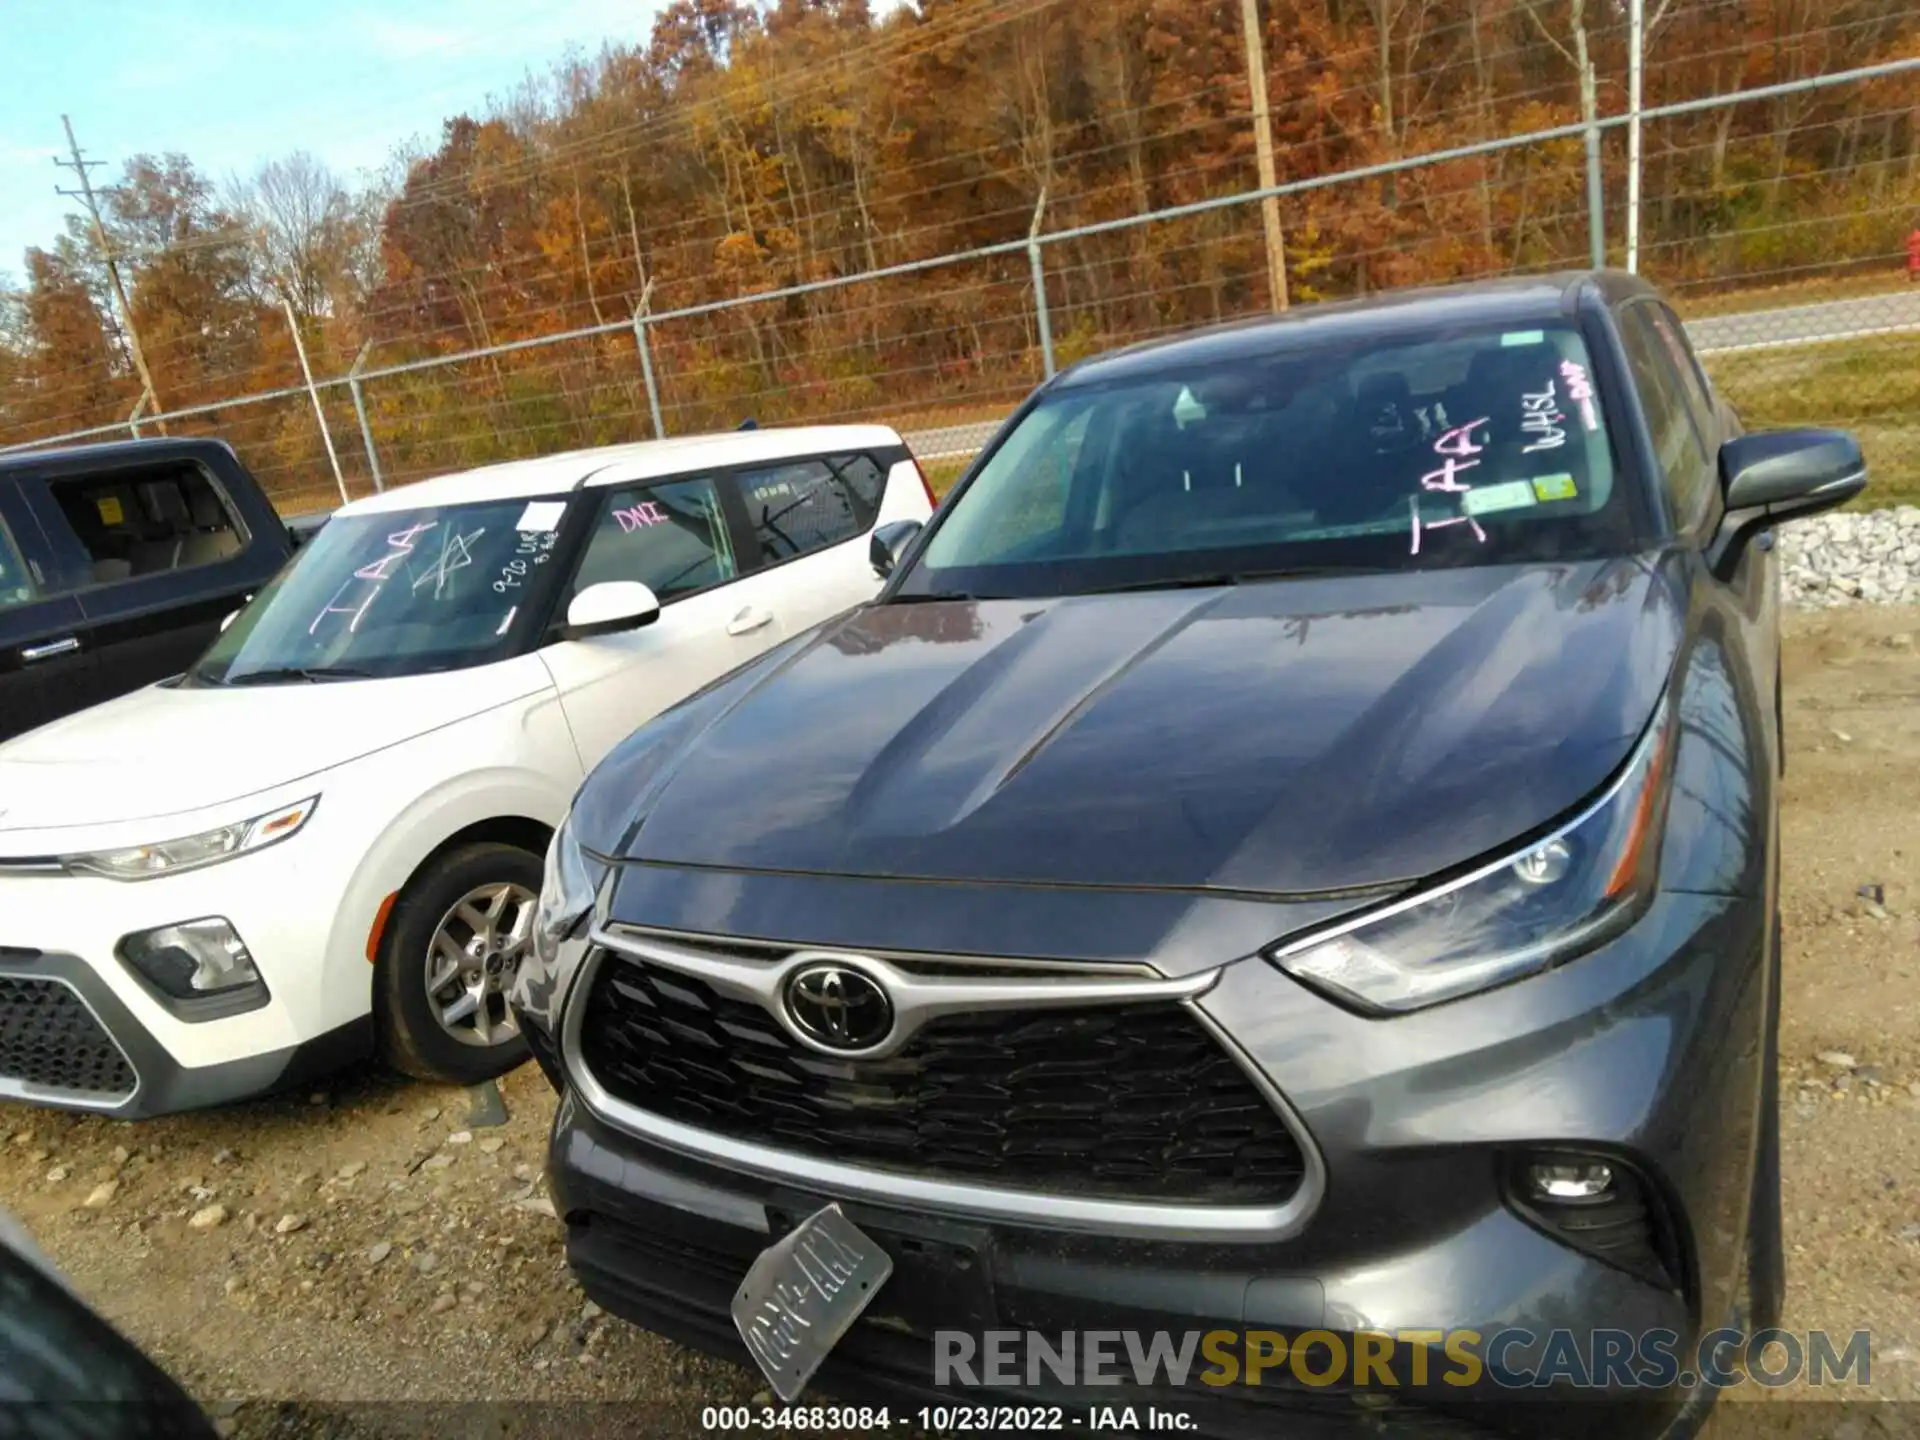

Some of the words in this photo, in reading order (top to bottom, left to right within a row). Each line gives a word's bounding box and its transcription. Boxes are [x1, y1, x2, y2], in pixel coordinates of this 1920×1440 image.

[611, 501, 669, 534] DNI
[1409, 415, 1491, 556] IAA
[308, 521, 439, 635] IAA
